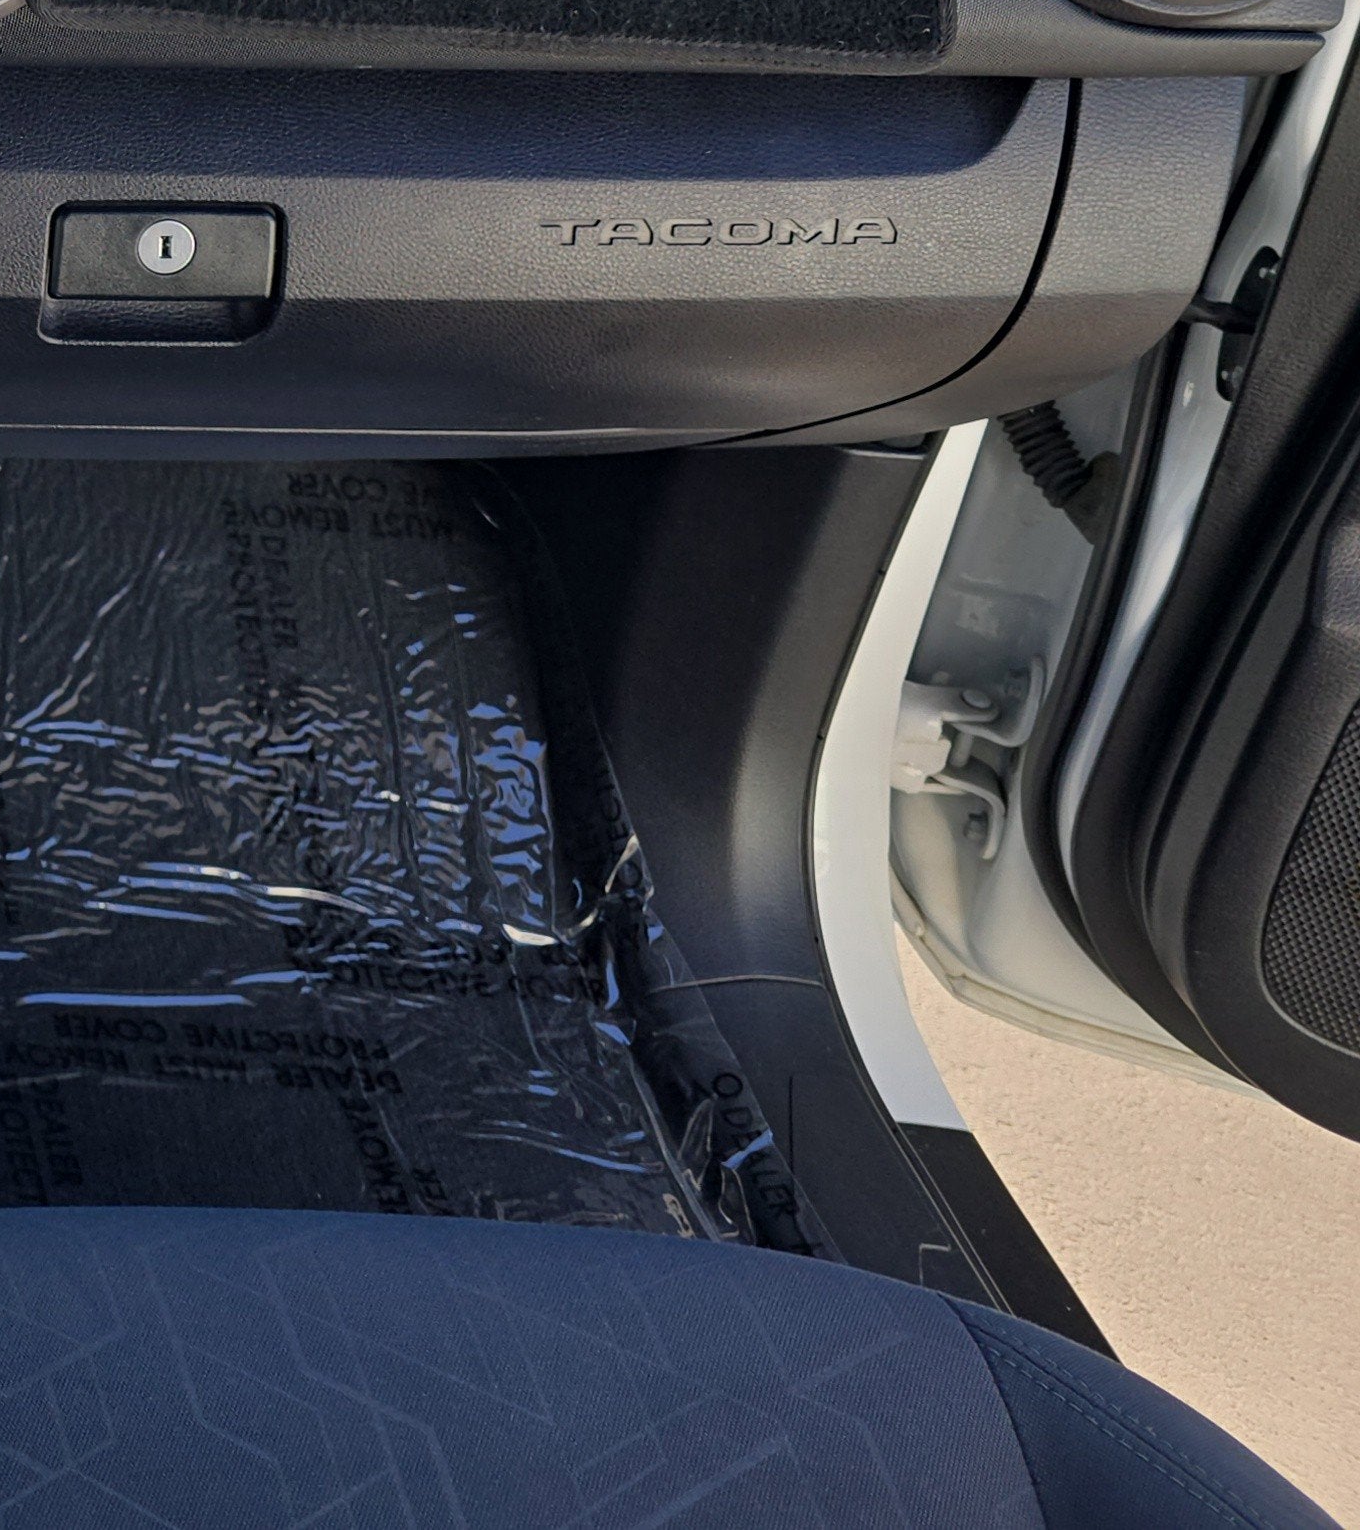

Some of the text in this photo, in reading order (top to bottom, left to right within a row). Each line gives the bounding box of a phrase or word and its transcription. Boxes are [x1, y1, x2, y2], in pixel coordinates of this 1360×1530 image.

[539, 216, 899, 246] TACOMA
[286, 471, 388, 503] COVER
[54, 1014, 389, 1061] PROTECTIVE COVER
[275, 1068, 402, 1095] DEALER
[31, 1078, 83, 1188] DEALER
